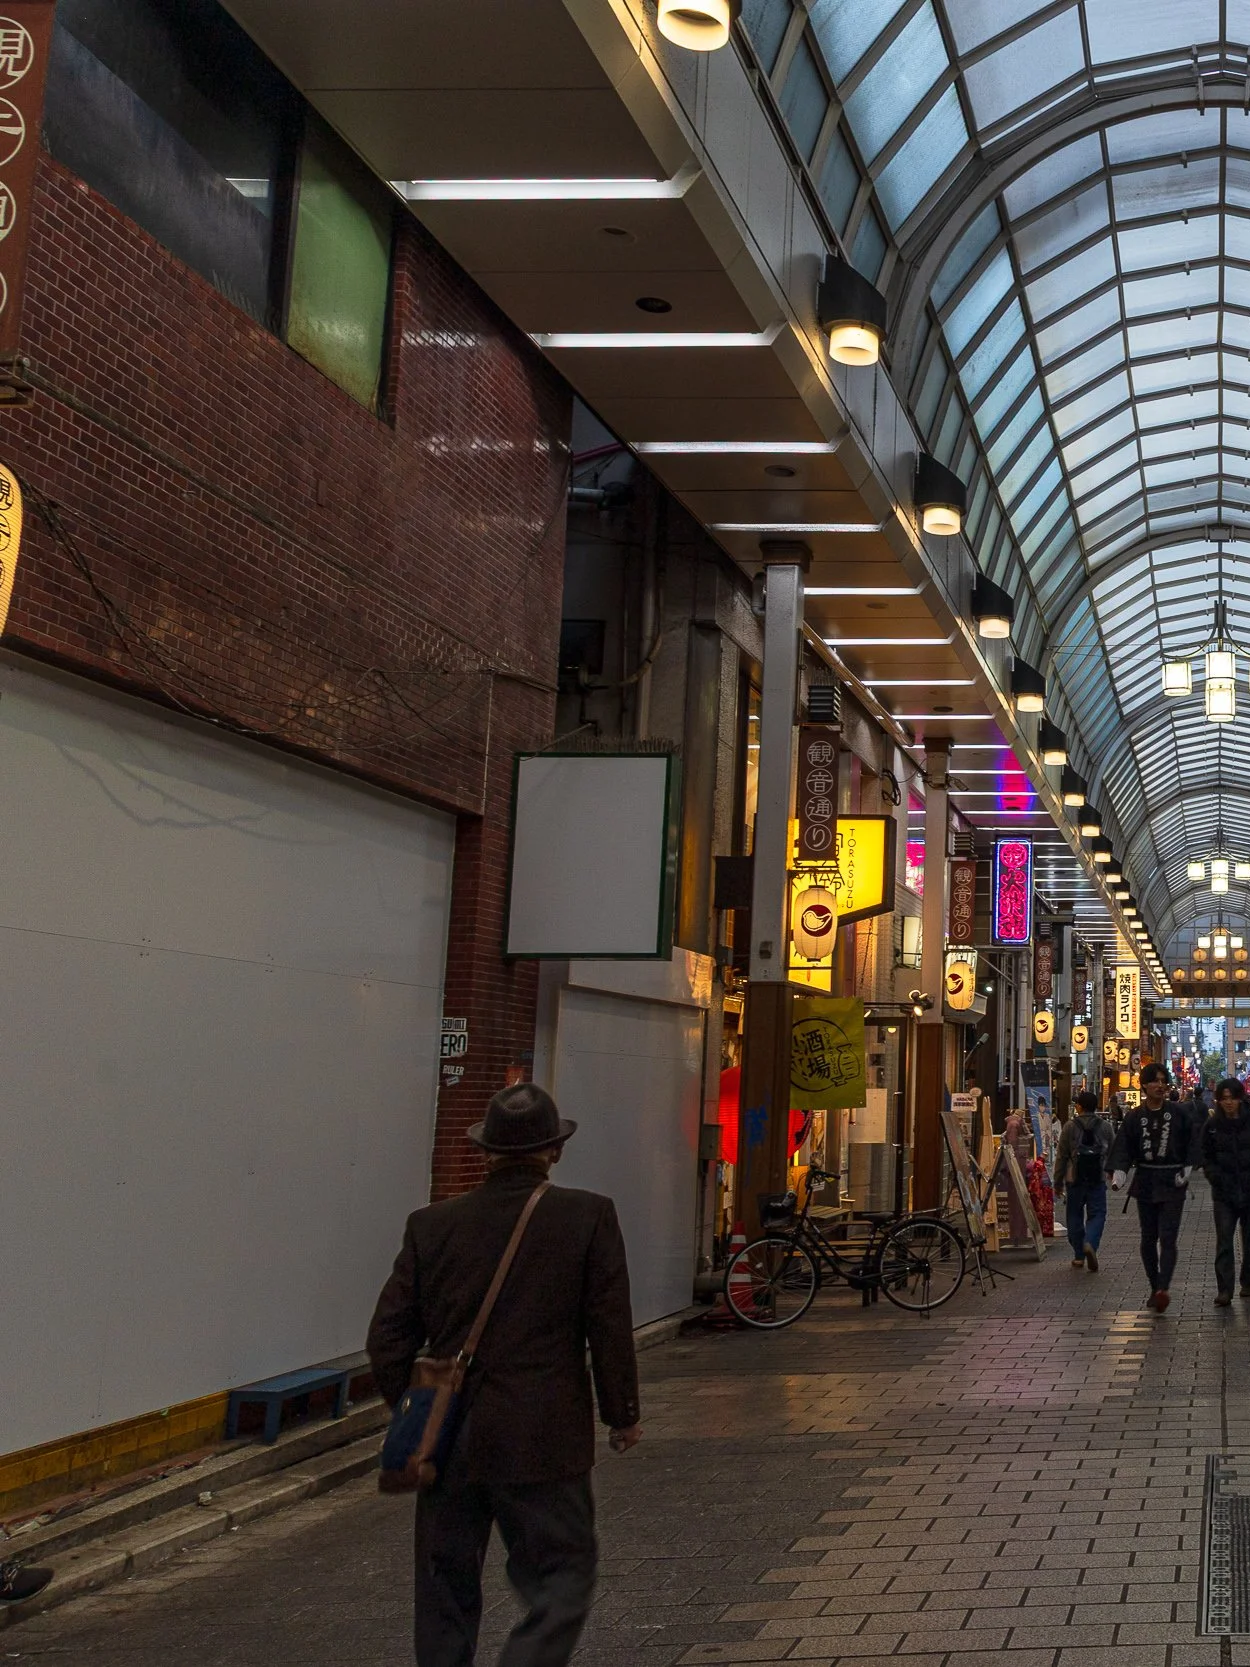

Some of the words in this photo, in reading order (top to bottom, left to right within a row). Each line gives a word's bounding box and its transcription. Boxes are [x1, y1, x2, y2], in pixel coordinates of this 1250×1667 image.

[804, 740, 835, 851] 観音通り
[846, 828, 857, 909] TORASUZU
[952, 867, 972, 939] 観音通り
[1037, 945, 1051, 996] 観音通り
[1119, 973, 1131, 1022] 焼肉ライク
[804, 1029, 830, 1079] 酒場
